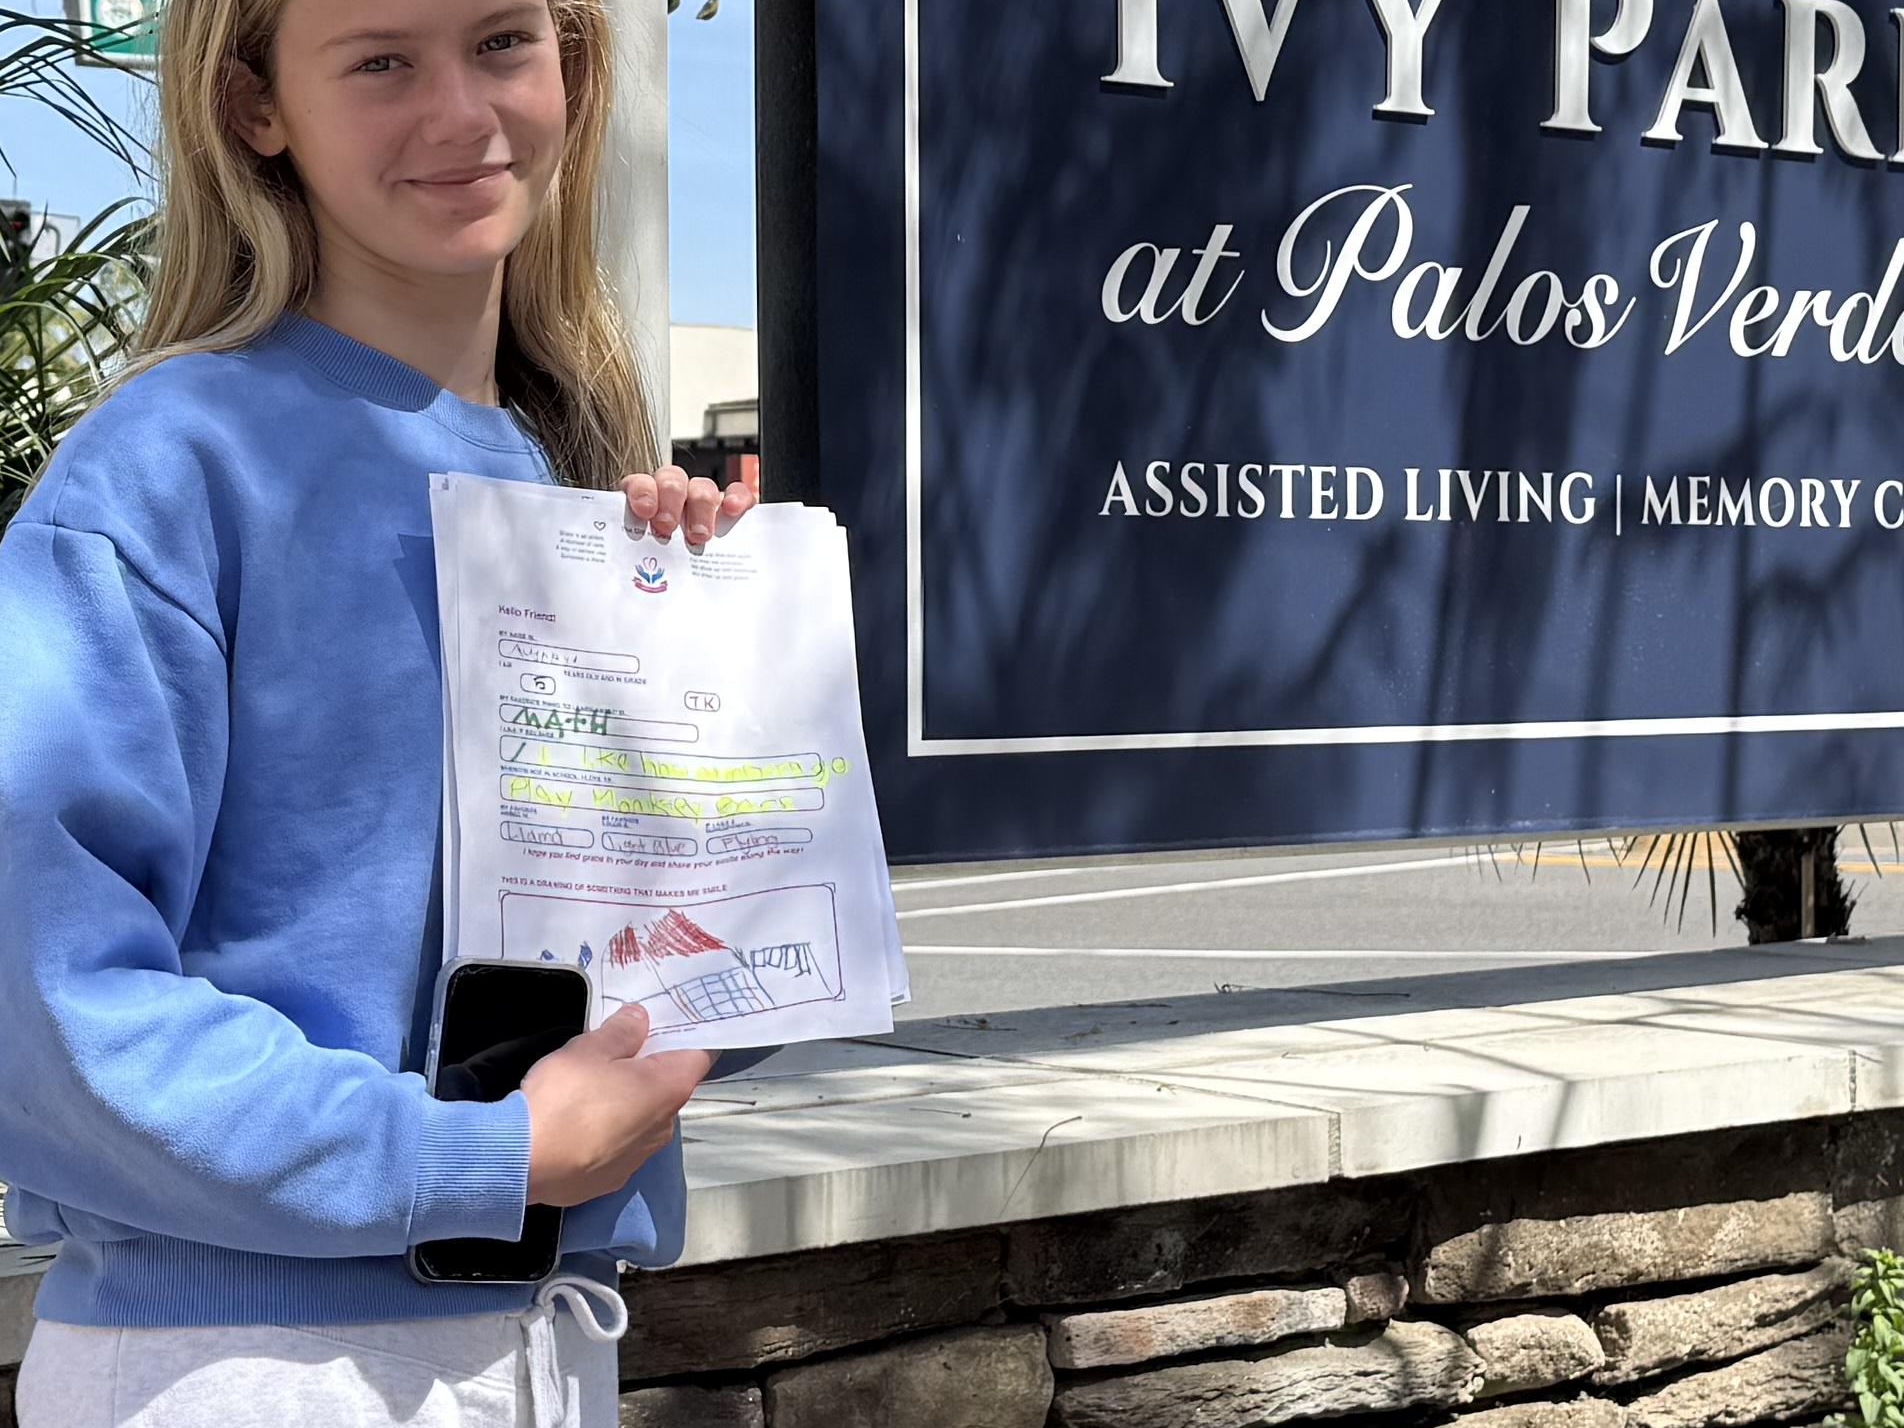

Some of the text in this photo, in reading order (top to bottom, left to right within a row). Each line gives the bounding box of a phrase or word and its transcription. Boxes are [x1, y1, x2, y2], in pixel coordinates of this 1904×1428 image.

[1100, 224, 1245, 326] at
[1261, 183, 1638, 351] Palos
[1099, 459, 1385, 524] ASSISTED
[1405, 468, 1597, 527] LIVING
[1641, 476, 1863, 529] MEMORY
[533, 675, 546, 690] 5
